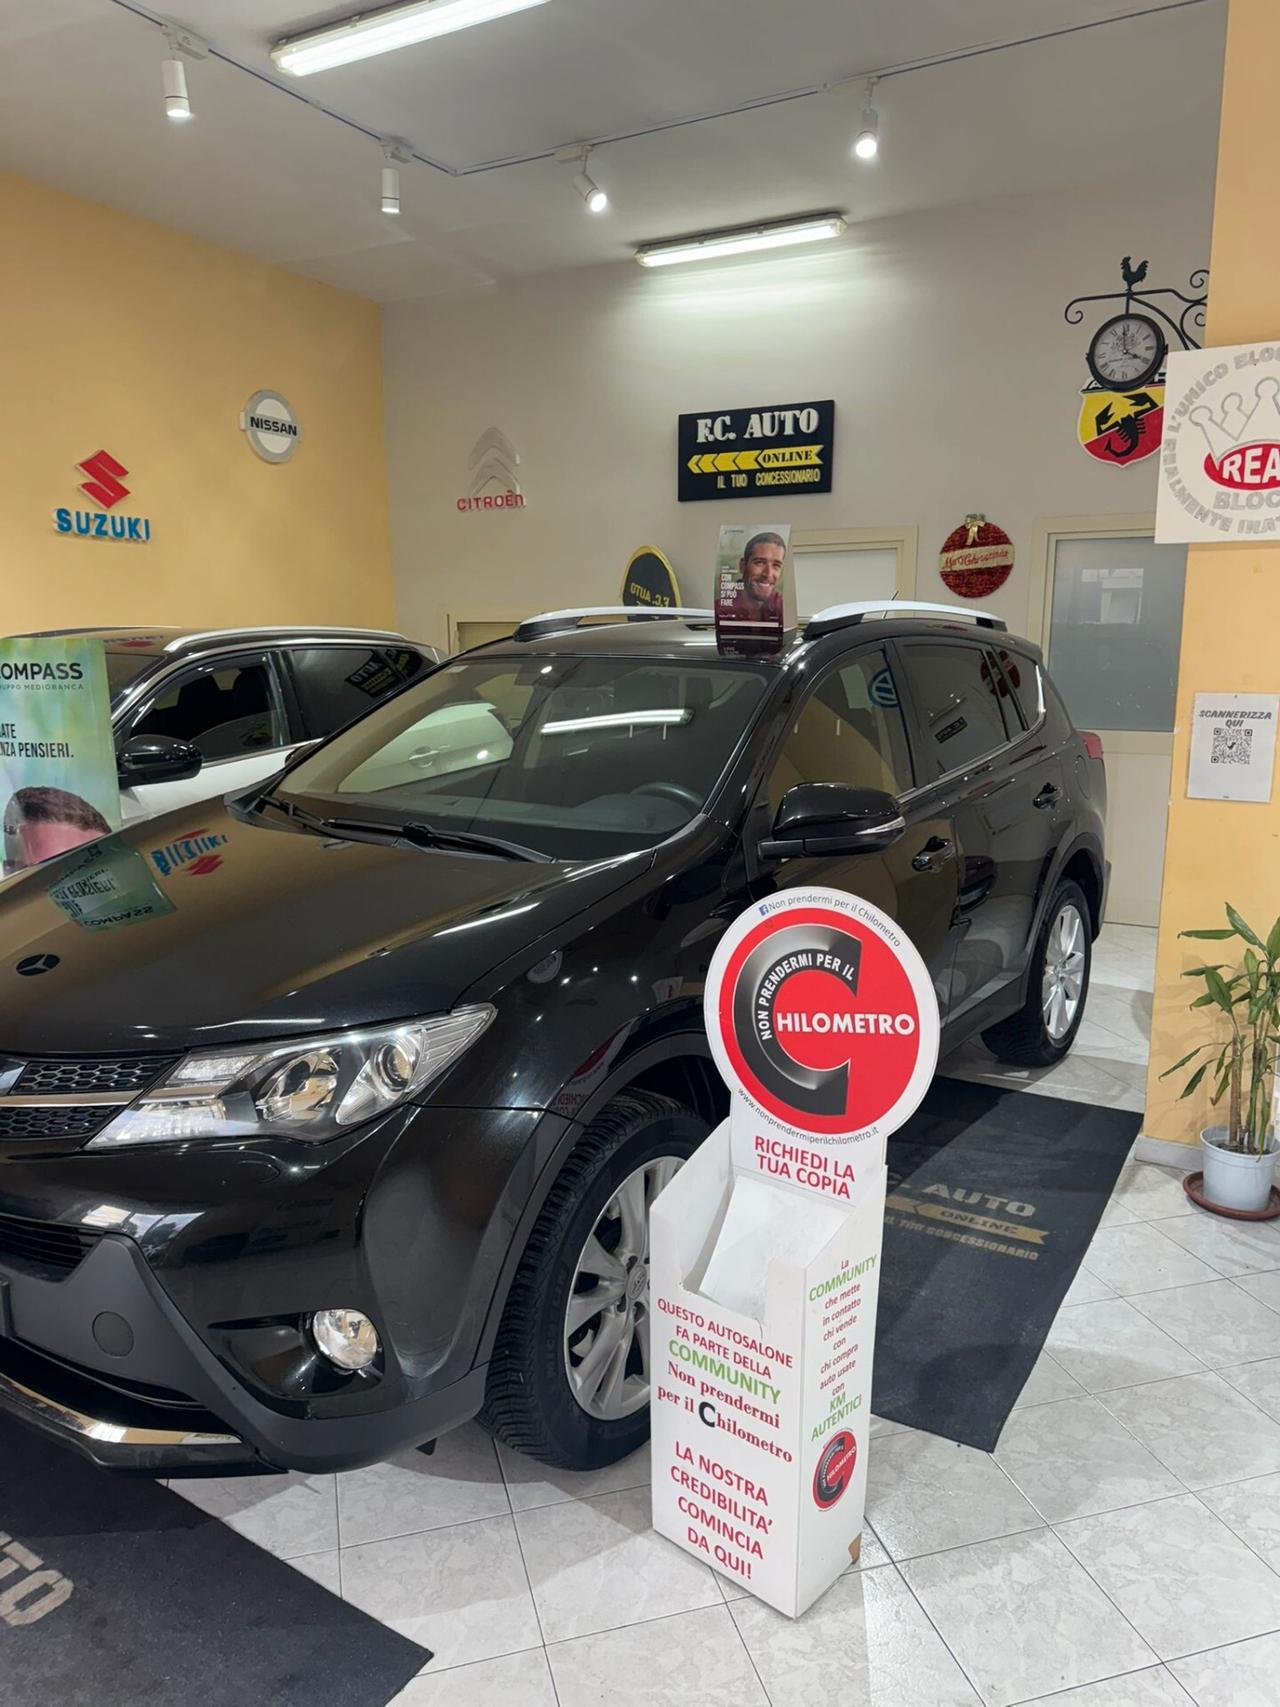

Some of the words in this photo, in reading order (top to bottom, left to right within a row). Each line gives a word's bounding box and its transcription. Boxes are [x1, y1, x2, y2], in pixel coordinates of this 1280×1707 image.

[250, 416, 297, 436] NISSAN
[696, 416, 737, 443] F.C.
[743, 408, 819, 438] AUTO
[763, 450, 813, 463] ONLINE
[717, 475, 726, 489] IL
[731, 474, 748, 488] TUO
[755, 468, 821, 486] CONCESSIONARIO
[54, 508, 150, 542] SUZUKI
[0, 663, 83, 680] OMPASS
[1199, 710, 1272, 720] SCANNERIZZA
[1225, 719, 1244, 728] QUI
[0, 723, 16, 739] ATE
[19, 743, 74, 758] PENSIERI.
[768, 899, 786, 911] Non
[788, 895, 833, 906] prendermi
[834, 897, 850, 910] per
[851, 903, 858, 913] il
[857, 907, 901, 948] Chilometro
[816, 953, 841, 972] PER
[842, 964, 855, 981] IL
[758, 953, 812, 1007] PRENDERMI
[758, 1010, 773, 1040] NON
[755, 1136, 828, 1172] RICHIEDI
[833, 1161, 856, 1182] LA
[757, 1154, 791, 1179] TUA
[796, 1168, 851, 1199] COPIA
[922, 1183, 1036, 1217] AUTO
[941, 1210, 1018, 1235] ONLINE
[809, 1254, 877, 1302] COMMUNITY
[841, 1260, 849, 1270] La
[825, 1296, 838, 1309] che
[840, 1284, 861, 1301] mette
[823, 1316, 830, 1327] in
[831, 1298, 861, 1321] contatto
[824, 1327, 834, 1341] chi
[836, 1314, 857, 1333] vende
[657, 1298, 705, 1328] QUESTO
[707, 1321, 793, 1368] AUTOSALONE
[833, 1337, 846, 1350] con
[676, 1325, 690, 1341] FA
[693, 1333, 730, 1360] PARTE
[733, 1352, 772, 1380] DELLA
[820, 1360, 831, 1374] chi
[832, 1344, 858, 1366] compra
[668, 1340, 781, 1404] COMMUNITY
[820, 1374, 836, 1390] auto
[837, 1360, 856, 1377] usate
[668, 1360, 696, 1387] Non
[700, 1381, 780, 1429] prendermi
[830, 1391, 846, 1412] KM
[832, 1382, 845, 1396] con
[657, 1386, 681, 1405] per
[685, 1396, 695, 1414] il
[698, 1401, 792, 1462] Chilometro
[811, 1394, 862, 1442] AUTENTICI
[676, 1441, 694, 1465] LA
[699, 1455, 768, 1506] NOSTRA
[671, 1465, 773, 1534] CREDIBILITA'
[678, 1496, 763, 1560] COMINCIA
[688, 1527, 710, 1554] DA
[714, 1545, 751, 1580] QUI!
